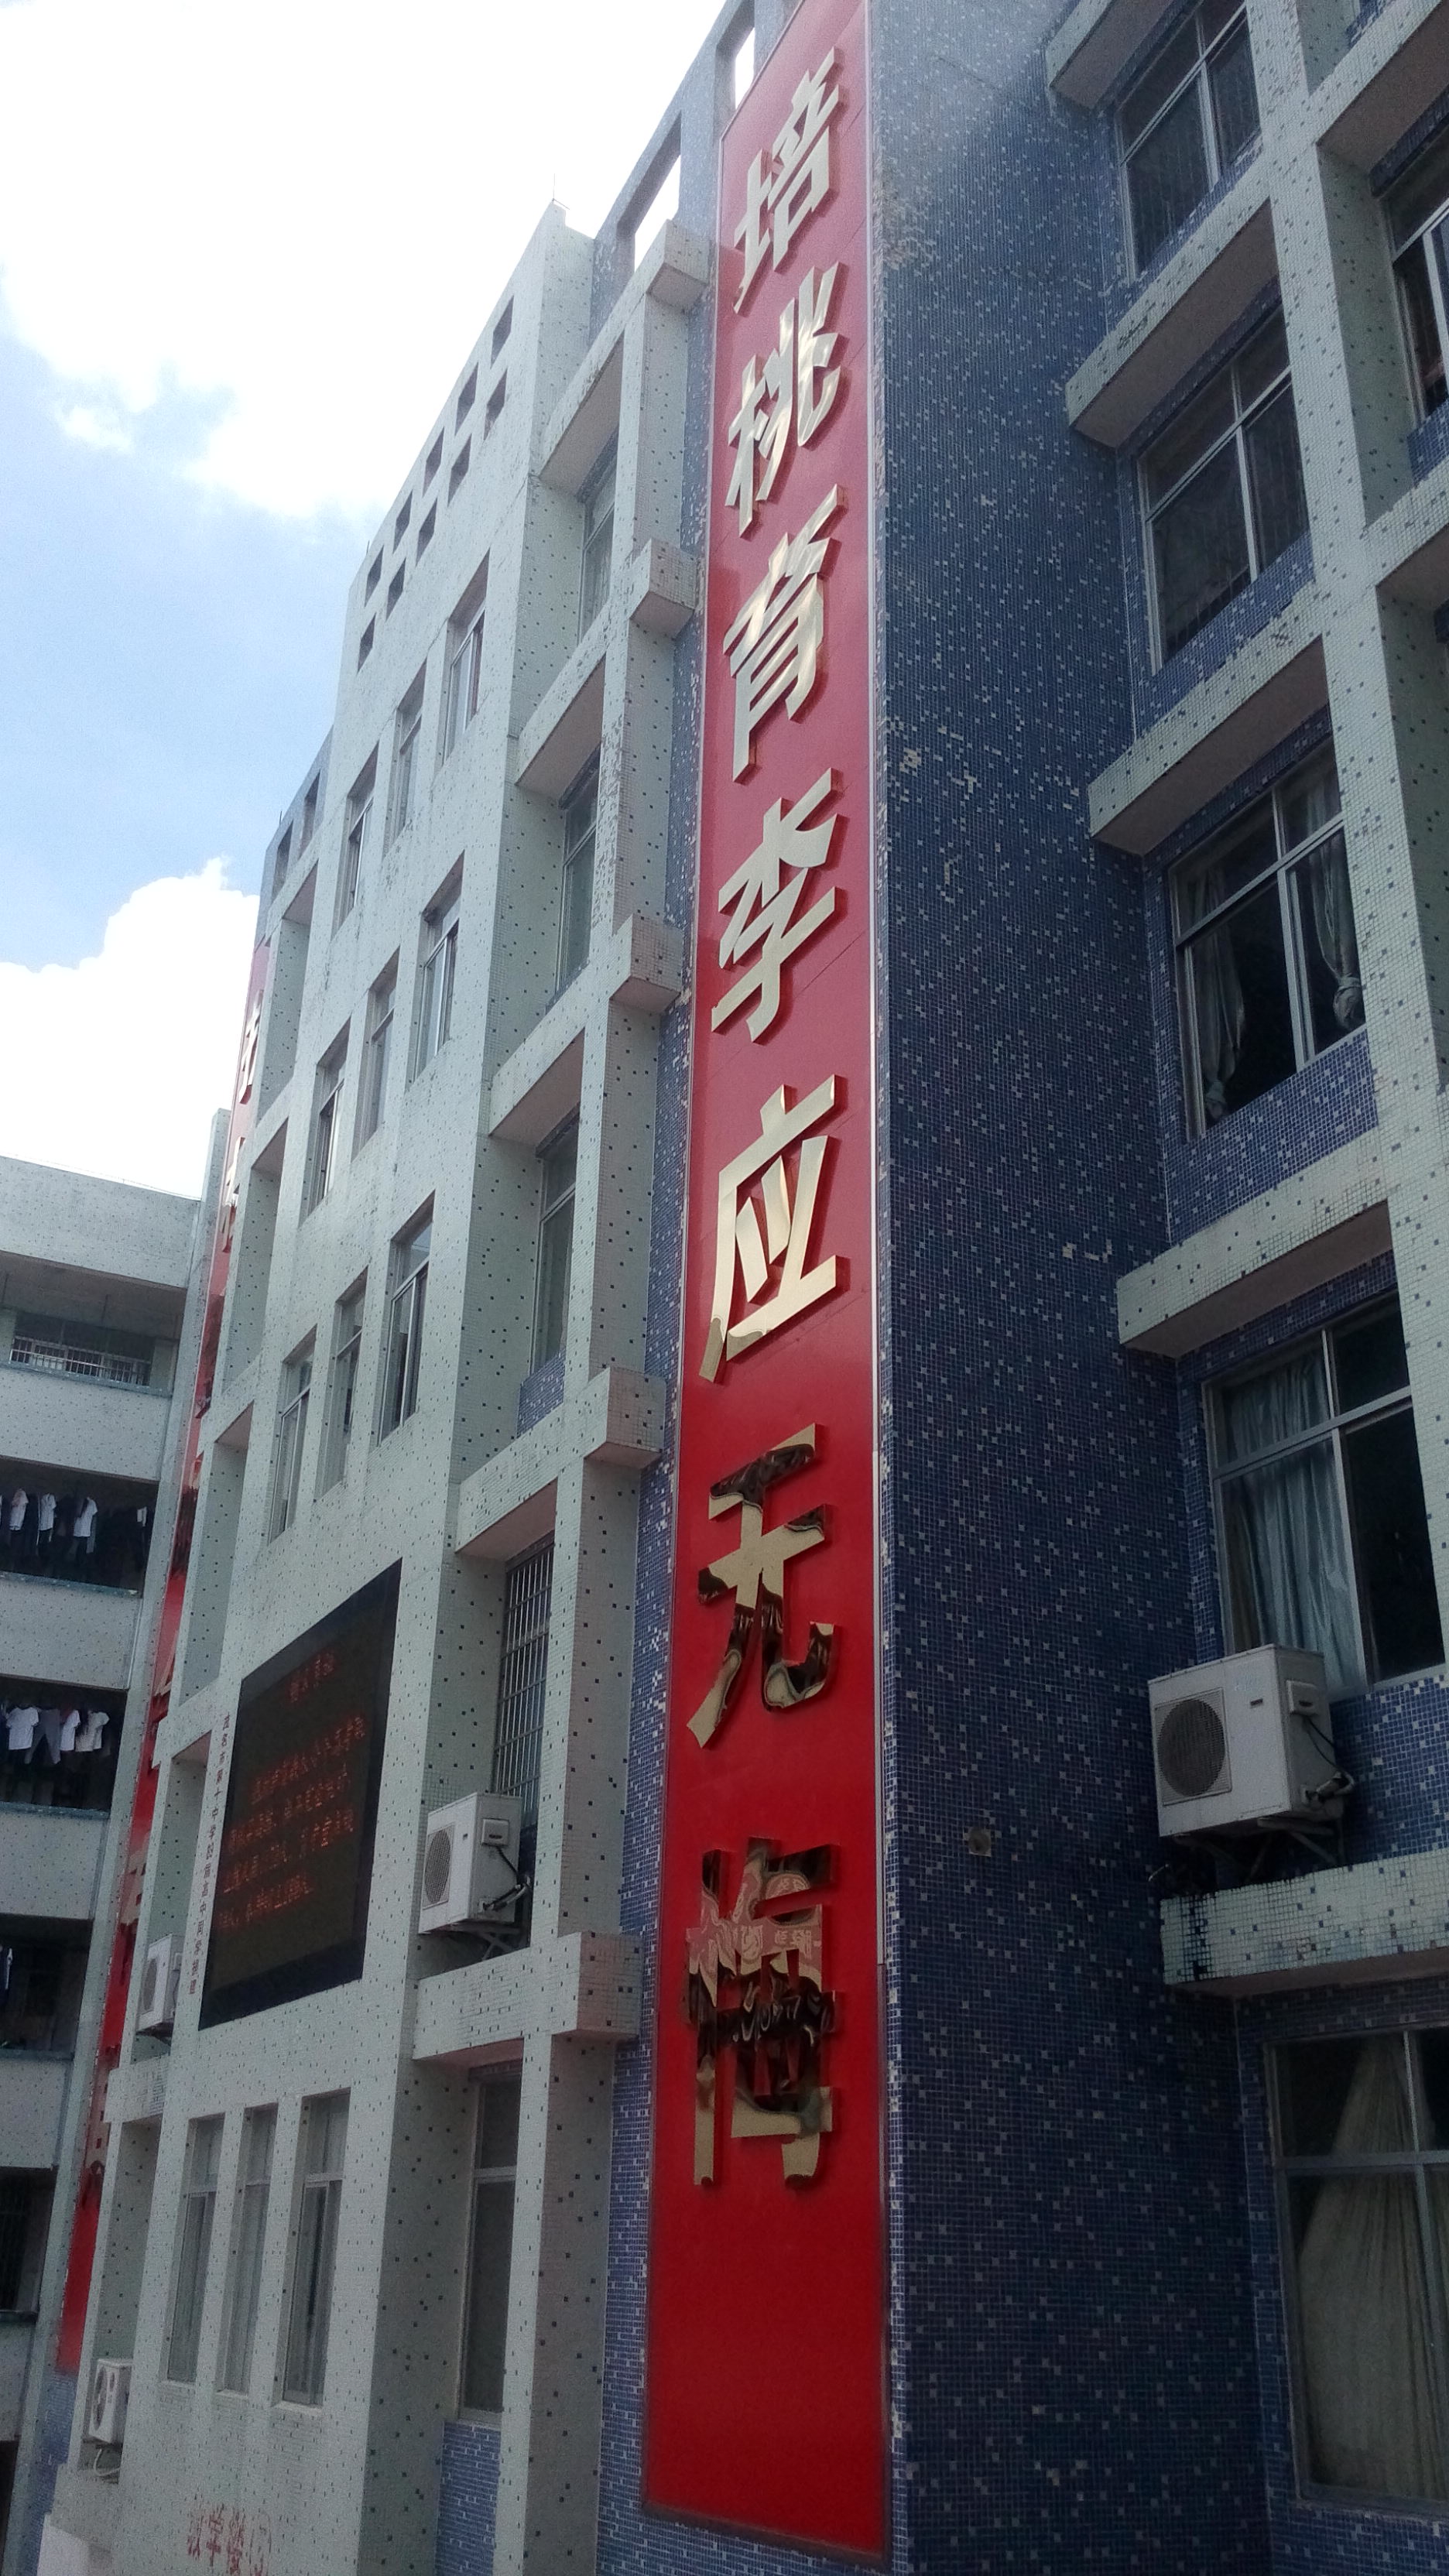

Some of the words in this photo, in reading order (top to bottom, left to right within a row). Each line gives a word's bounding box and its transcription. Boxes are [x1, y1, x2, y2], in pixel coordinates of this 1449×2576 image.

[687, 46, 837, 2189] 培桃育李应无悔
